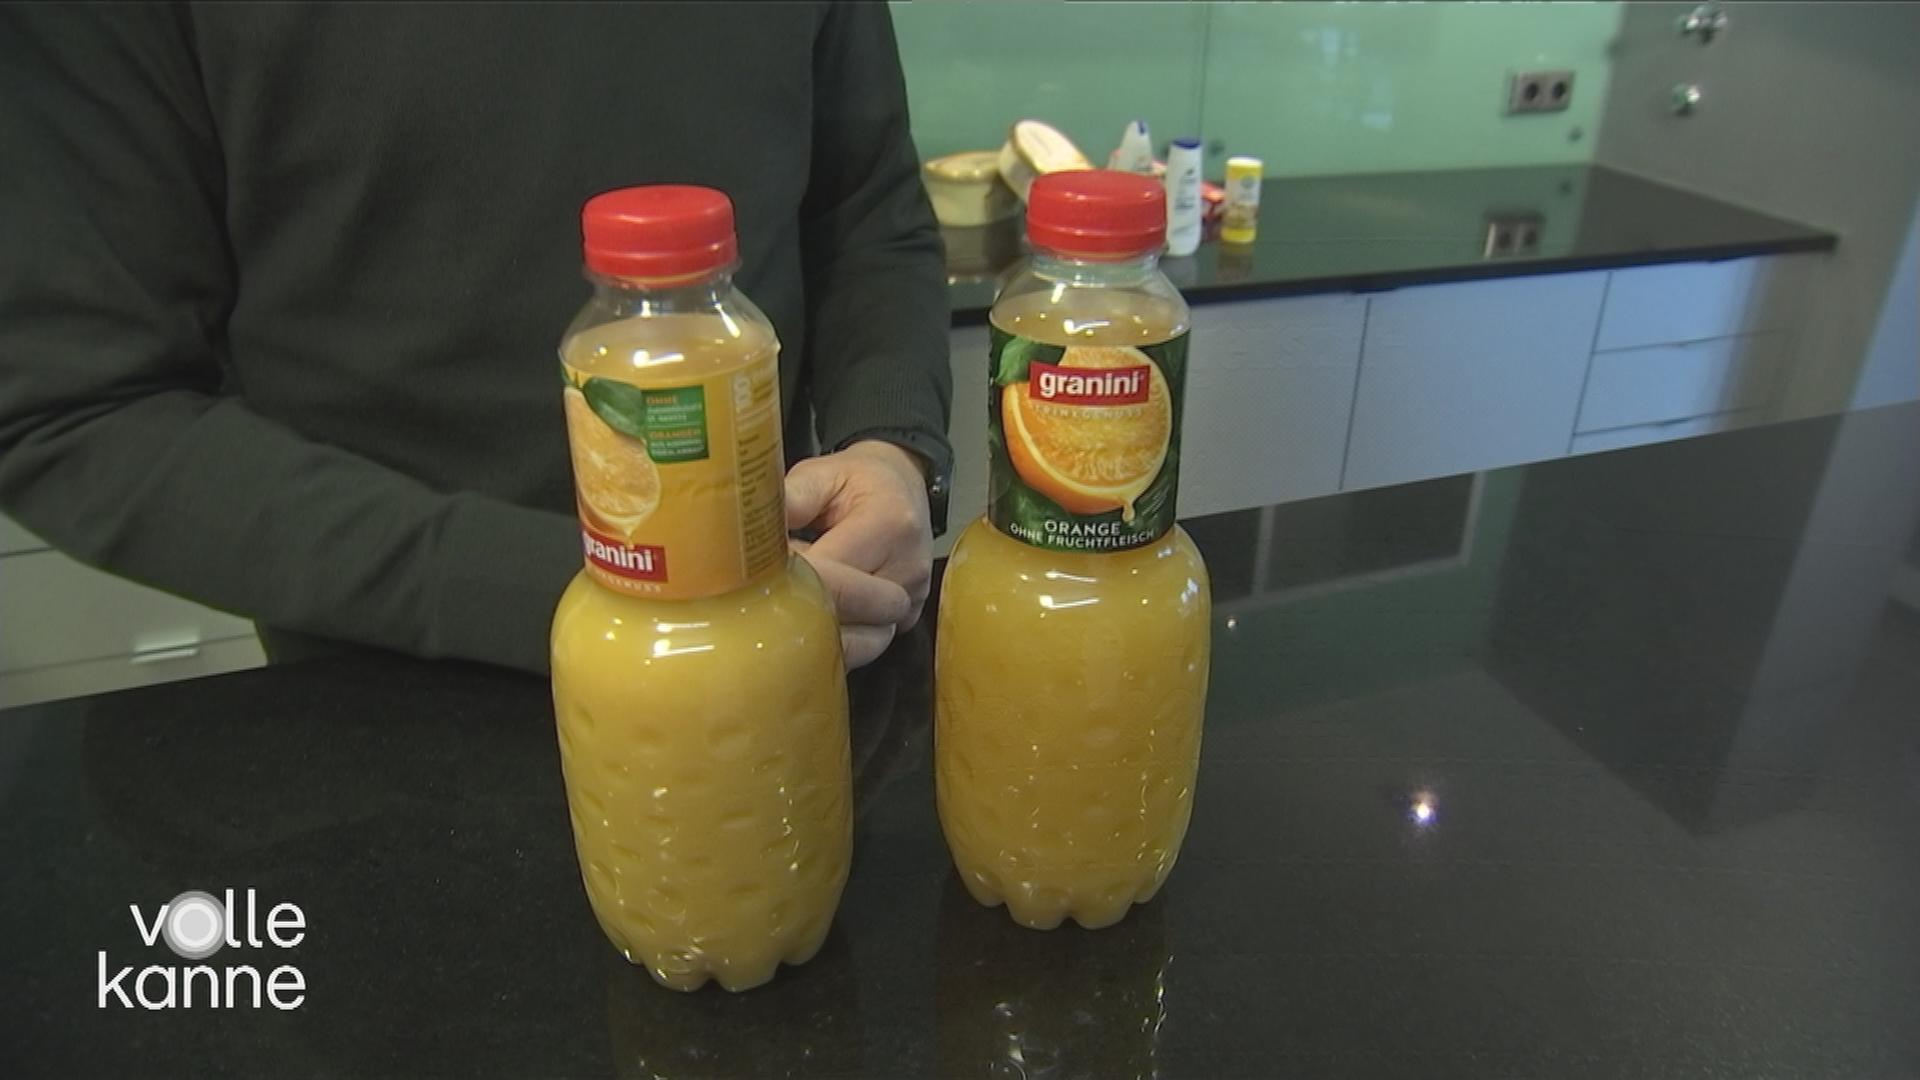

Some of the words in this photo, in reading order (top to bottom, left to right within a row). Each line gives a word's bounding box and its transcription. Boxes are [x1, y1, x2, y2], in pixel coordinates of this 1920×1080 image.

[1038, 371, 1141, 398] granini
[1009, 522, 1043, 543] OHNE
[1047, 529, 1155, 549] FRUCHTFLEISCH
[1044, 519, 1121, 537] ORANGE
